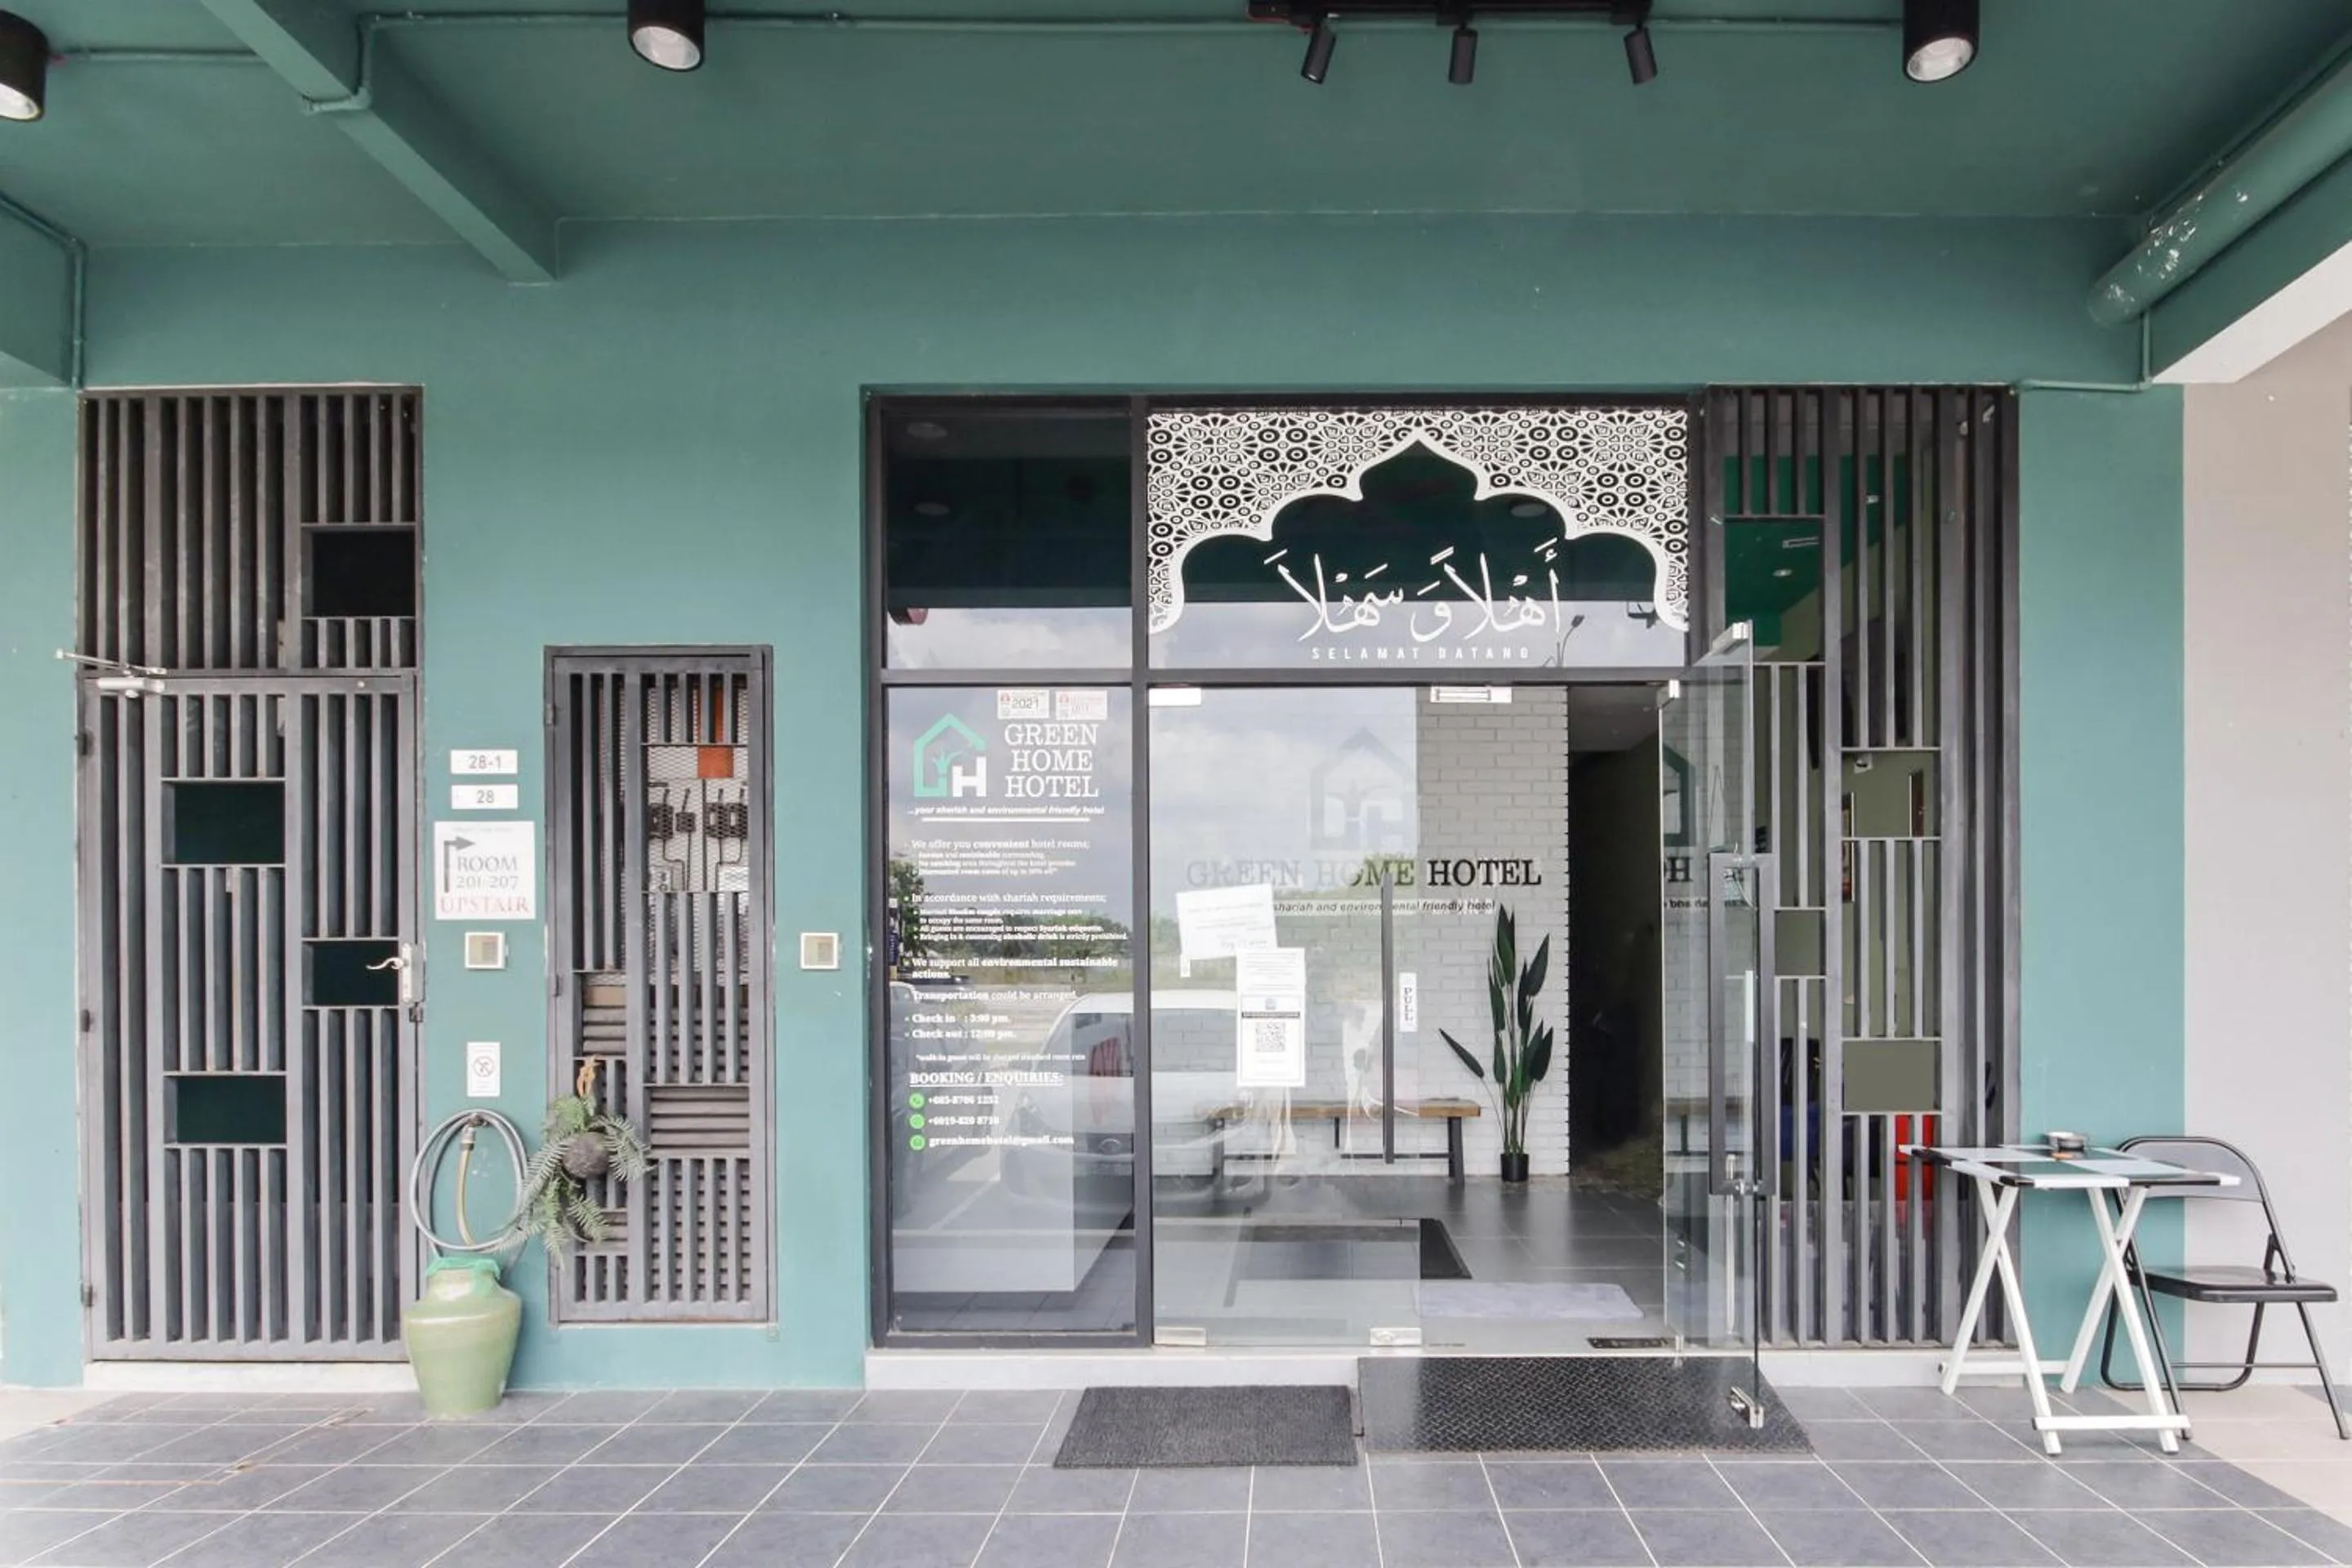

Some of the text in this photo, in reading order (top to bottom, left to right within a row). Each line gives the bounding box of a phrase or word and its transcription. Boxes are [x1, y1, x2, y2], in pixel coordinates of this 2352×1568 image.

[1312, 648, 1420, 659] SELAMAT
[1004, 724, 1099, 746] GREEN
[468, 755, 501, 769] 28-1
[1010, 750, 1093, 772] HOME
[1004, 775, 1098, 797] HOTEL
[476, 789, 495, 804] 28
[969, 805, 986, 814] and
[911, 840, 927, 849] We
[929, 840, 952, 849] offer
[953, 842, 971, 851] you
[973, 840, 1029, 849] convenient
[1031, 840, 1055, 849] hotel
[457, 856, 519, 872] ROOM
[1187, 859, 1542, 887] GREEN HOME HOTEL
[912, 893, 922, 902] In
[924, 893, 978, 902] accordance
[979, 893, 1001, 902] with
[441, 897, 529, 914] UPSTAIR
[1316, 902, 1337, 911] and
[1421, 901, 1463, 913] friendly
[1467, 901, 1496, 911] hotel
[912, 957, 1119, 969] We support all environmental sustainable
[913, 991, 989, 1003] Transportation
[991, 991, 1018, 1000] could
[1018, 991, 1031, 1000] be
[912, 1013, 942, 1023] Check
[944, 1013, 956, 1023] in
[912, 1030, 942, 1039] Check
[944, 1030, 962, 1039] out
[910, 1072, 974, 1085] BOOKING
[984, 1071, 1064, 1086] ENQUIRIES:
